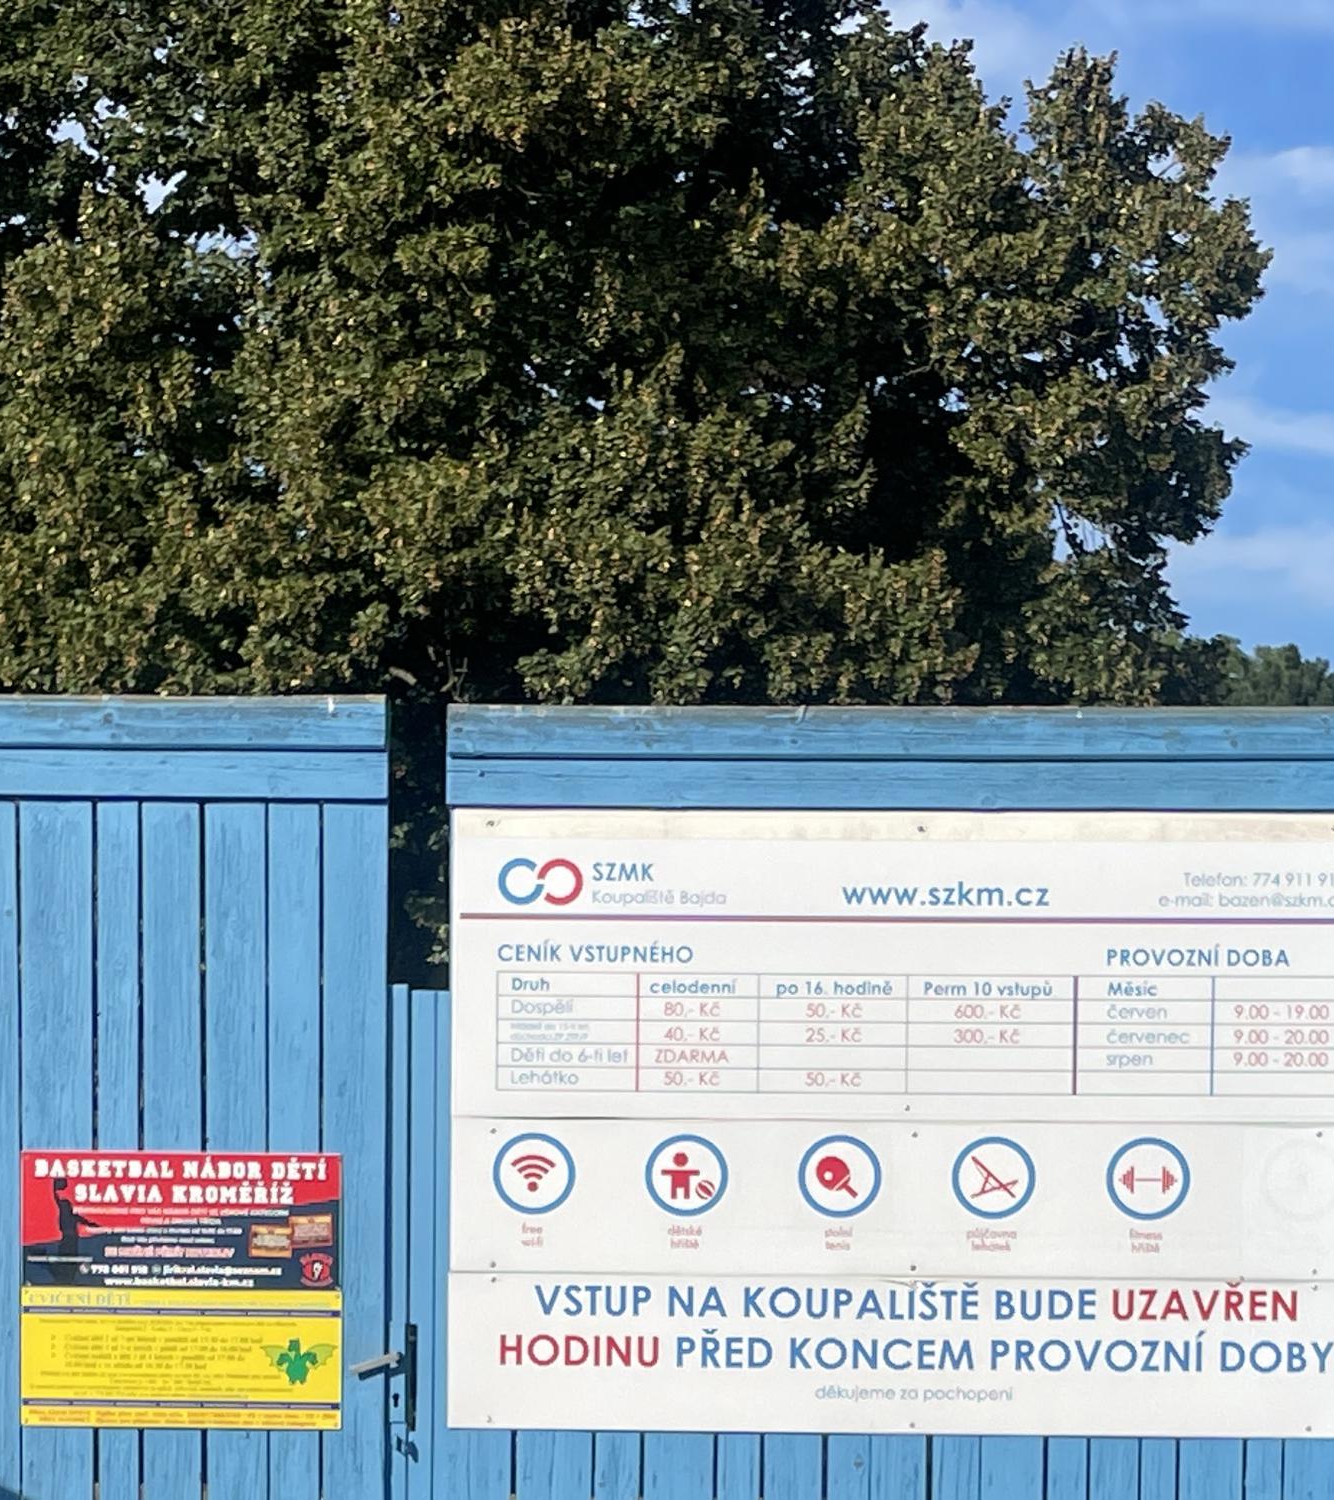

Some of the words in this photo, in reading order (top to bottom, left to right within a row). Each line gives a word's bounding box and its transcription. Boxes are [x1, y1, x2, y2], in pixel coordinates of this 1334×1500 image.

[592, 863, 654, 882] SZMK
[1184, 872, 1247, 887] Telefon:
[1253, 873, 1280, 887] 774
[1285, 873, 1311, 887] 911
[592, 889, 674, 906] Koupaliště
[680, 890, 727, 907] Bajda
[843, 881, 1050, 906] www.szkm.cz
[1158, 893, 1213, 907] e-mail:
[498, 940, 560, 963] CENÍK
[571, 942, 693, 963] VSTUPNÉHO
[1106, 943, 1219, 967] PROVOZNÍ
[1227, 948, 1290, 967] DOBA
[511, 978, 550, 991] Druh
[649, 978, 736, 995] celodenní
[775, 982, 798, 998] po
[834, 980, 893, 996] hodině
[924, 982, 966, 996] Perm
[973, 982, 991, 996] 10
[997, 981, 1053, 1000] vstupů
[1107, 981, 1157, 997] Měsíc
[511, 998, 574, 1016] Dospělí
[699, 1001, 720, 1017] Kč
[841, 1003, 863, 1018] Kč
[999, 1004, 1021, 1019] Kč
[1107, 1004, 1167, 1019] červen
[1234, 1005, 1269, 1020] 9.00
[1286, 1004, 1329, 1020] 19.00
[699, 1026, 720, 1041] Kč
[841, 1028, 862, 1042] Kč
[999, 1029, 1021, 1044] Kč
[1107, 1029, 1190, 1045] červenec
[1234, 1029, 1269, 1045] 9.00
[1284, 1029, 1329, 1045] 20.00
[511, 1047, 545, 1063] Děti
[550, 1048, 573, 1063] do
[578, 1048, 603, 1063] 6-ti
[607, 1048, 629, 1063] let
[654, 1049, 729, 1064] ZDARMA
[1107, 1053, 1152, 1070] srpen
[1233, 1052, 1268, 1067] 9.00
[1284, 1052, 1328, 1068] 20.00
[511, 1070, 579, 1086] Lehátko
[699, 1071, 720, 1086] Kč
[840, 1072, 861, 1087] Kč
[34, 1158, 174, 1178] BASKETBAL
[182, 1156, 262, 1179] NÁBOR
[271, 1157, 327, 1180] DĚTÍ
[74, 1183, 163, 1203] SLAVIA
[171, 1181, 294, 1204] KROMĚŘÍŽ
[534, 1284, 652, 1317] VSTUP
[668, 1285, 727, 1318] NA
[743, 1281, 980, 1322] KOUPALIŠTĚ
[995, 1288, 1097, 1322] BUDE
[1112, 1281, 1299, 1322] UZAVŘEN
[499, 1333, 660, 1368] HODINU
[676, 1328, 773, 1369] PŘED
[789, 1336, 974, 1371] KONCEM
[990, 1330, 1203, 1372] PROVOZNÍ
[1220, 1340, 1334, 1374] DOBY
[815, 1384, 896, 1402] děkujeme
[900, 1387, 918, 1400] za
[923, 1384, 1014, 1404] pochopení
